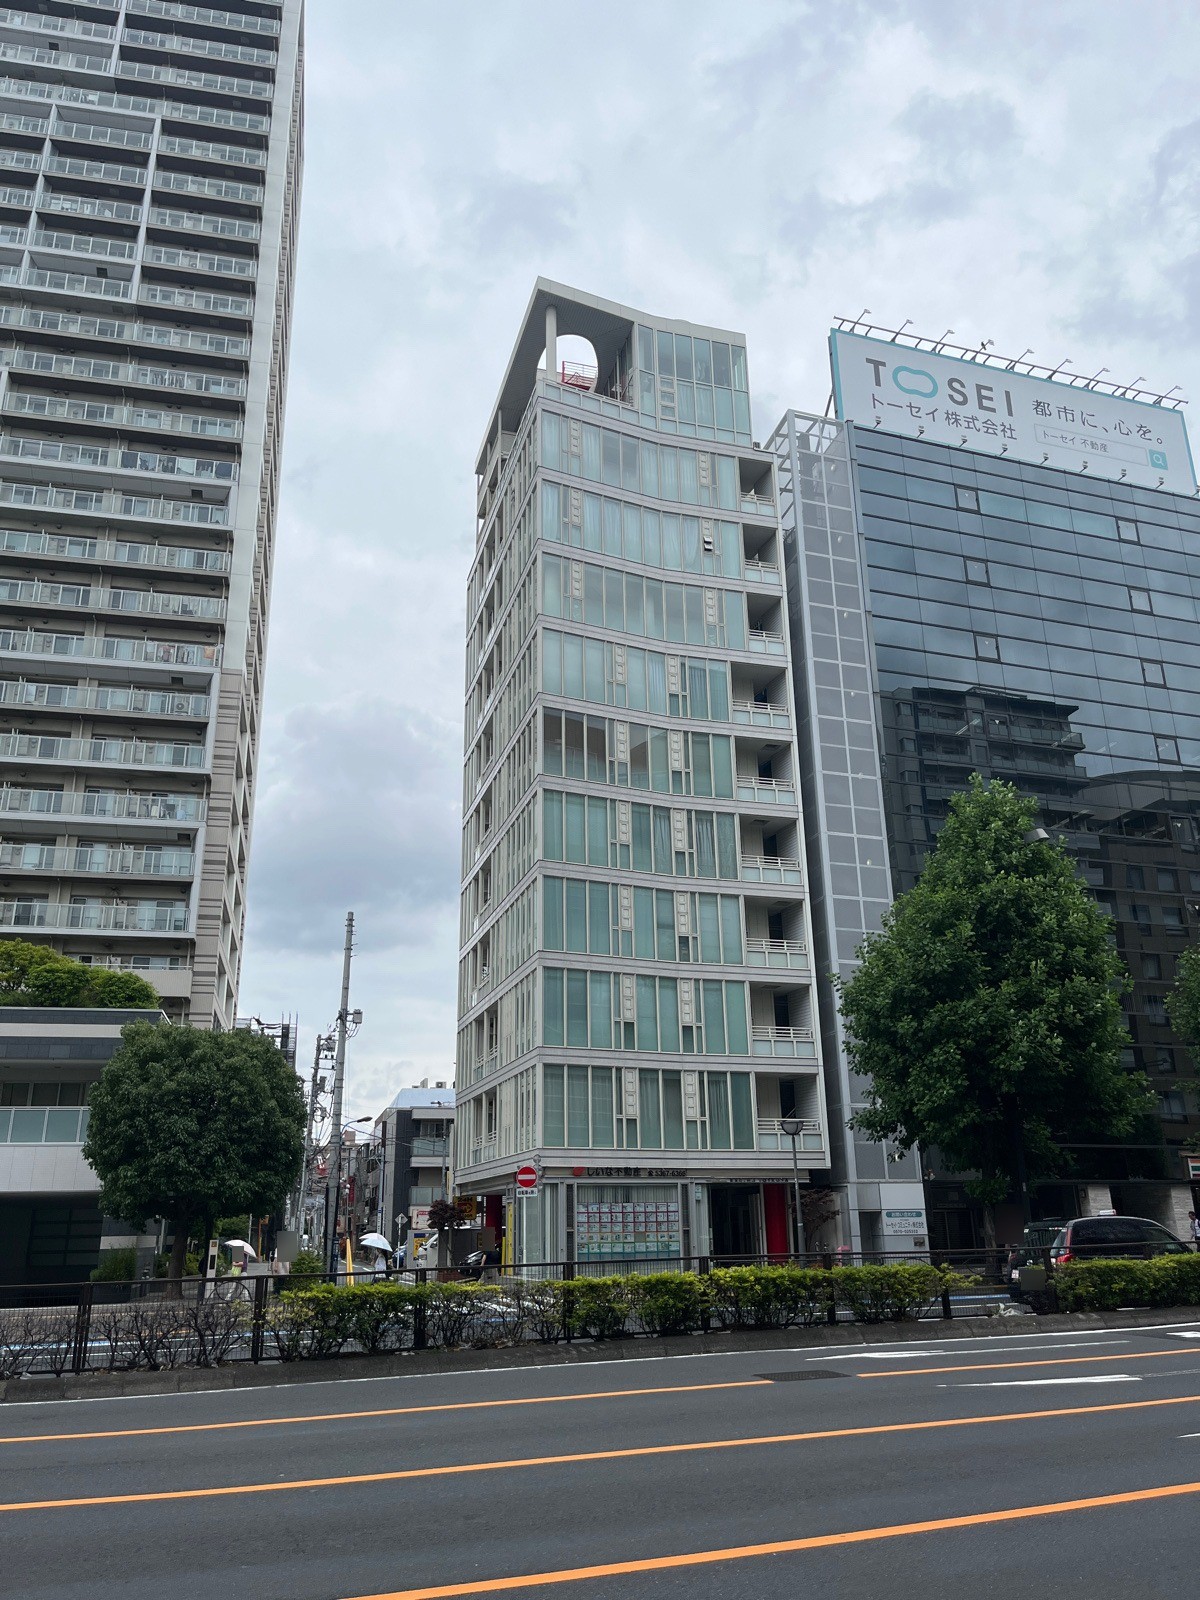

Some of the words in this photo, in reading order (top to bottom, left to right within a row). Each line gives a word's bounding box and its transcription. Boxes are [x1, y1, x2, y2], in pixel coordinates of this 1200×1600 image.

[865, 357, 1014, 417] TOSEI
[871, 393, 1018, 441] トーセイ株式会社
[1031, 399, 1163, 445] 都市に、心を。
[586, 1166, 642, 1177] しいな不動産
